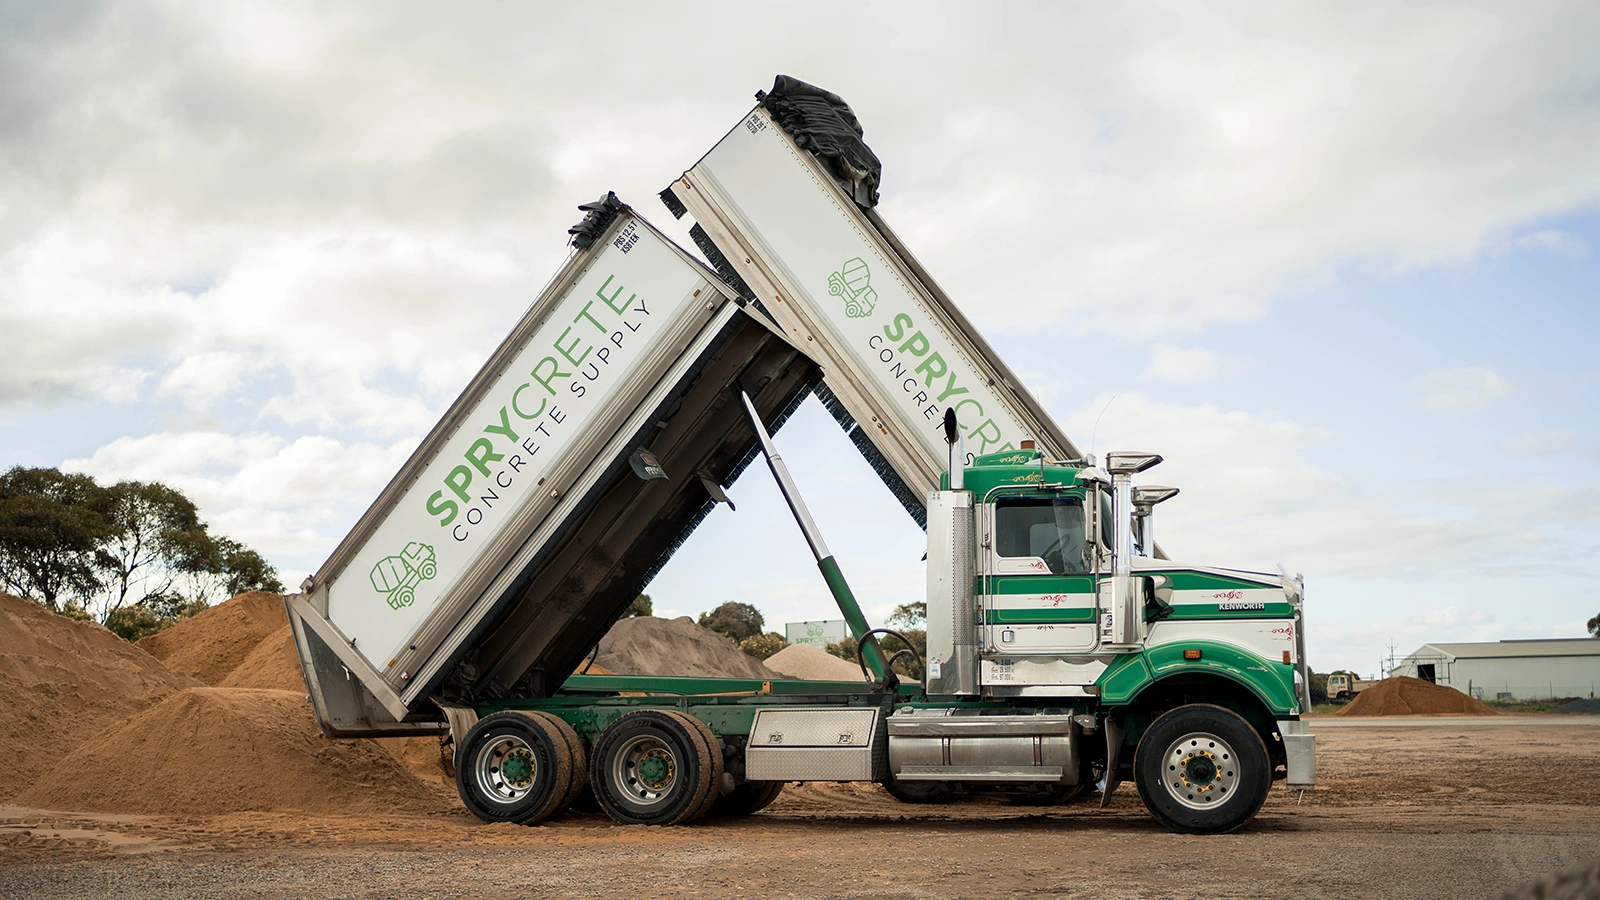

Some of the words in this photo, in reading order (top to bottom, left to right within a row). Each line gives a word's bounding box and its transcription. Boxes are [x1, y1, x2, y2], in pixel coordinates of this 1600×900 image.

[613, 235, 626, 249] PBS
[426, 274, 637, 527] SPRYCRETE
[453, 406, 567, 541] CONCRETE
[571, 299, 650, 397] SUPPLY
[795, 636, 837, 644] SPRYCRETE
